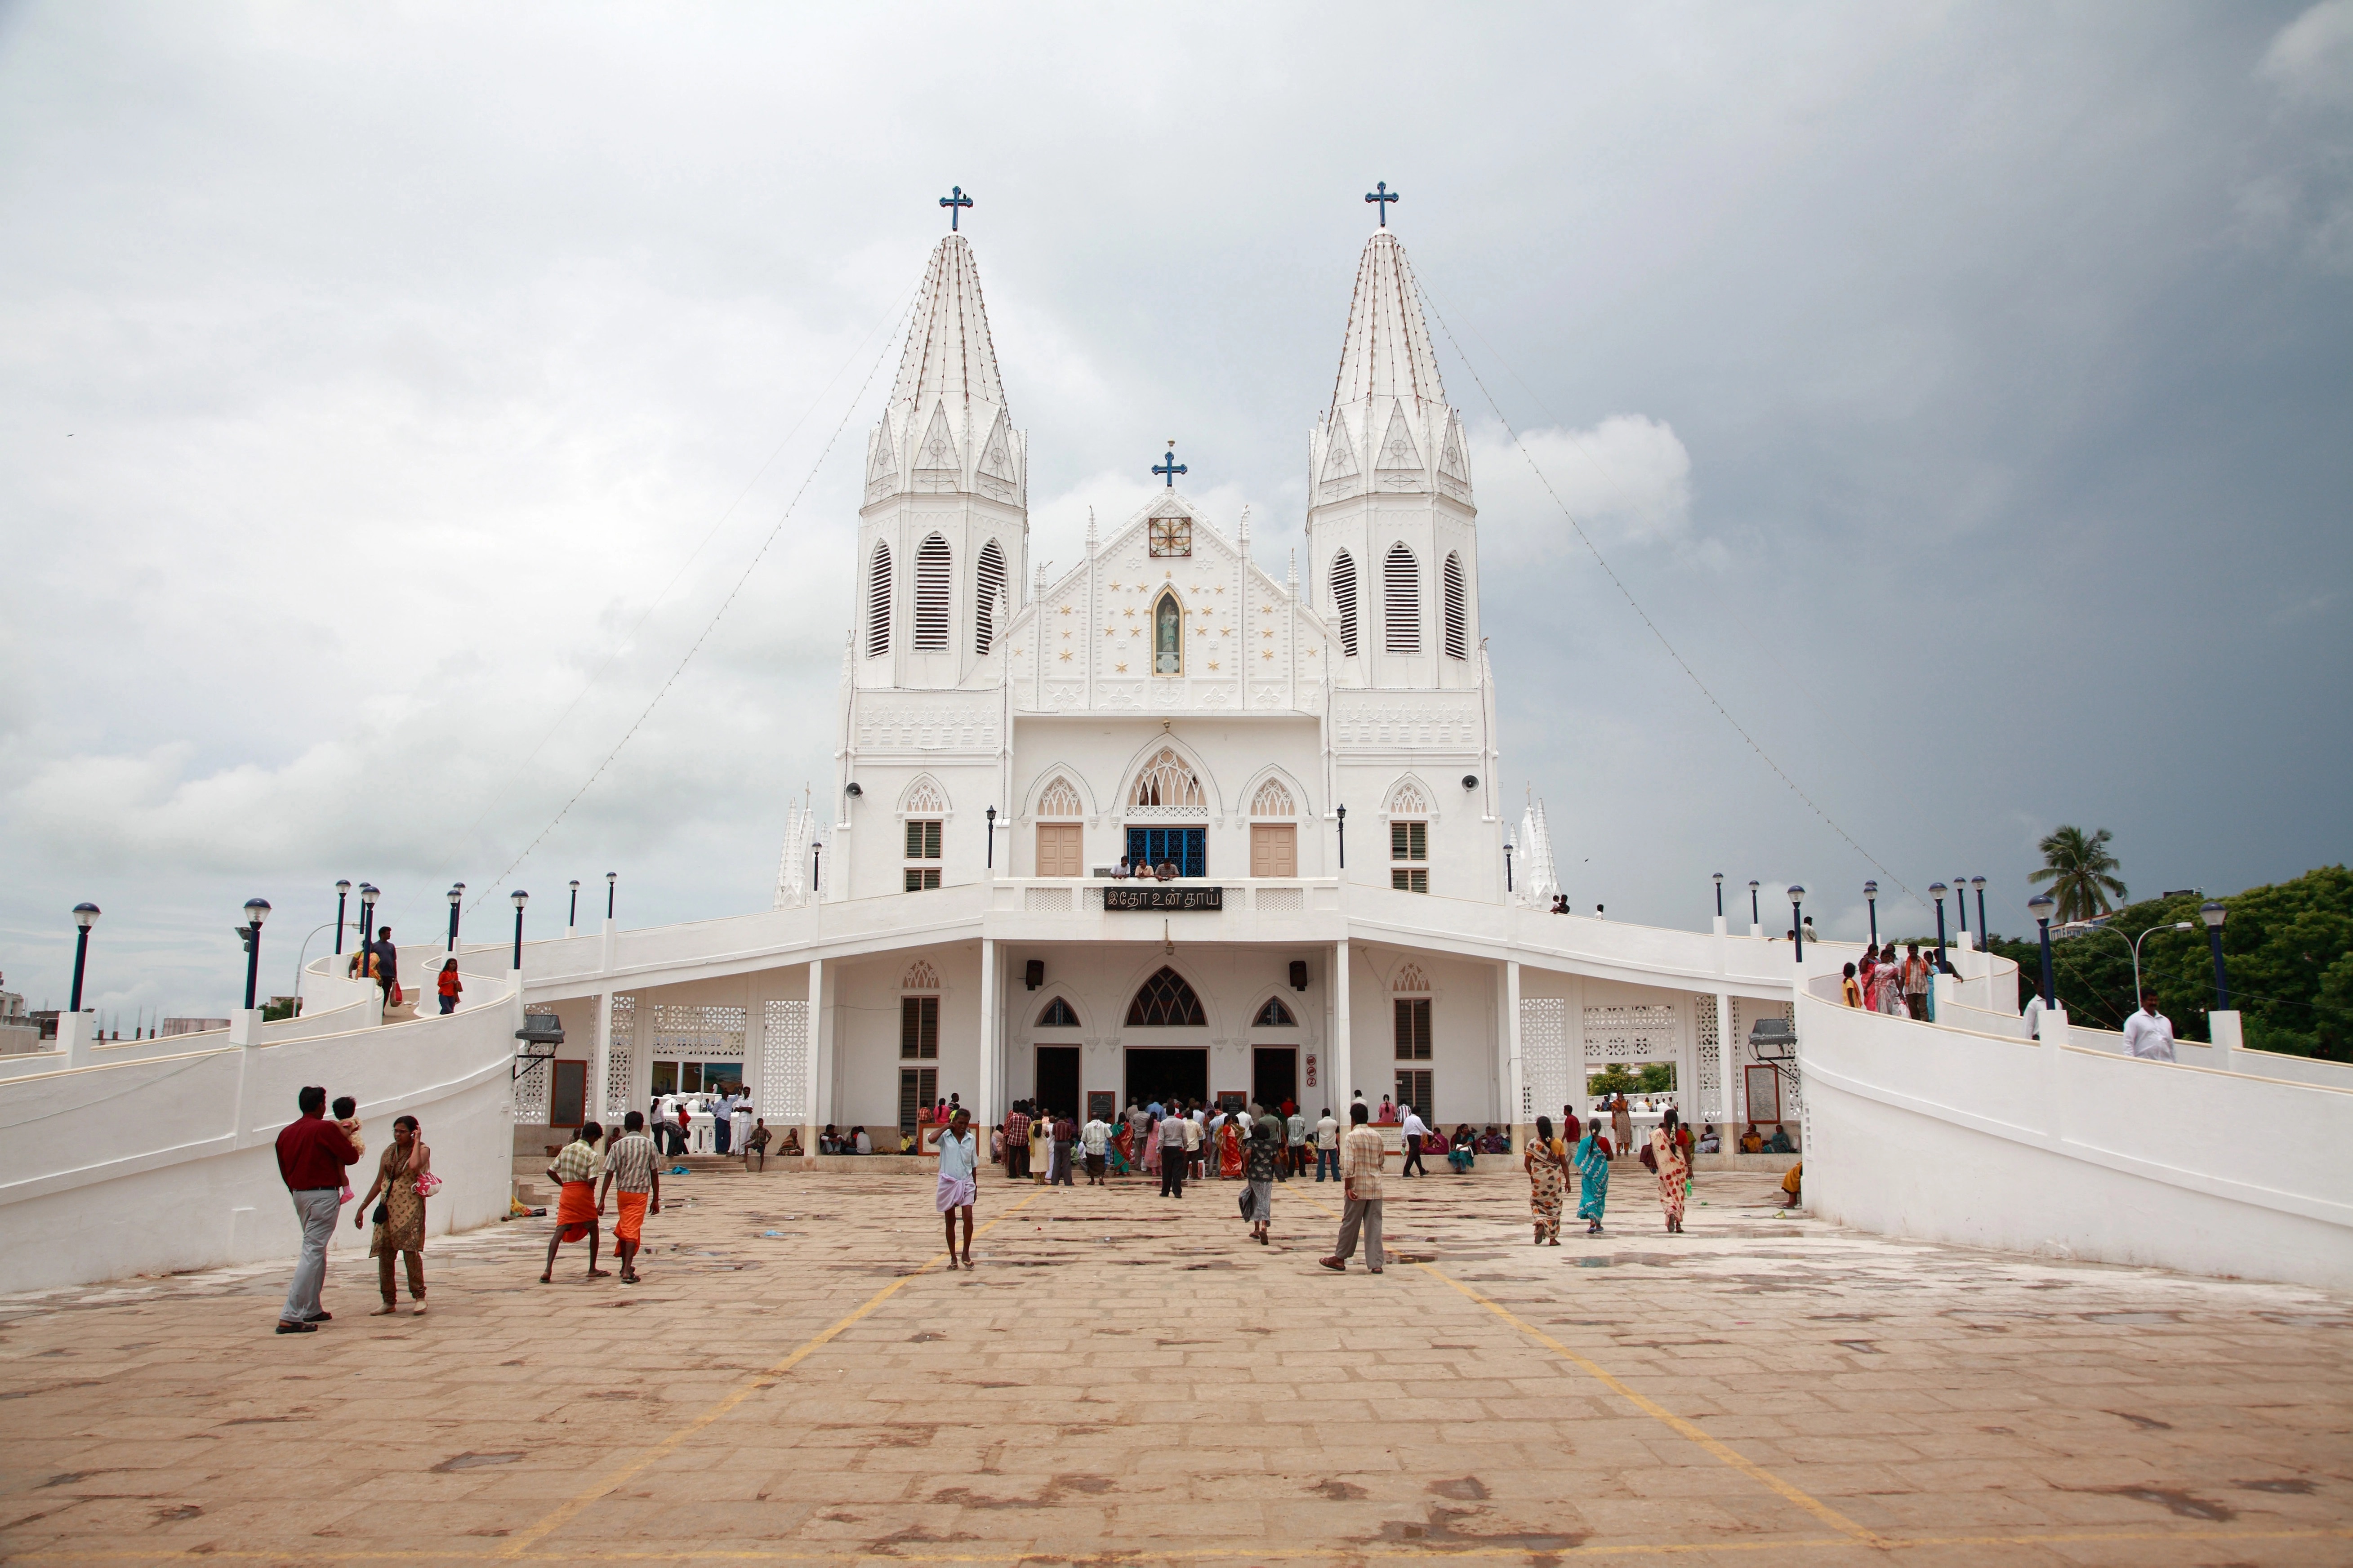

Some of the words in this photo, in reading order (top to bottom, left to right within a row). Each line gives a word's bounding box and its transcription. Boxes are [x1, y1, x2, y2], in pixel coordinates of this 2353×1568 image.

[1108, 891, 1148, 908] இதோ
[1152, 888, 1182, 905] உன்
[1184, 888, 1219, 908] தாய்
